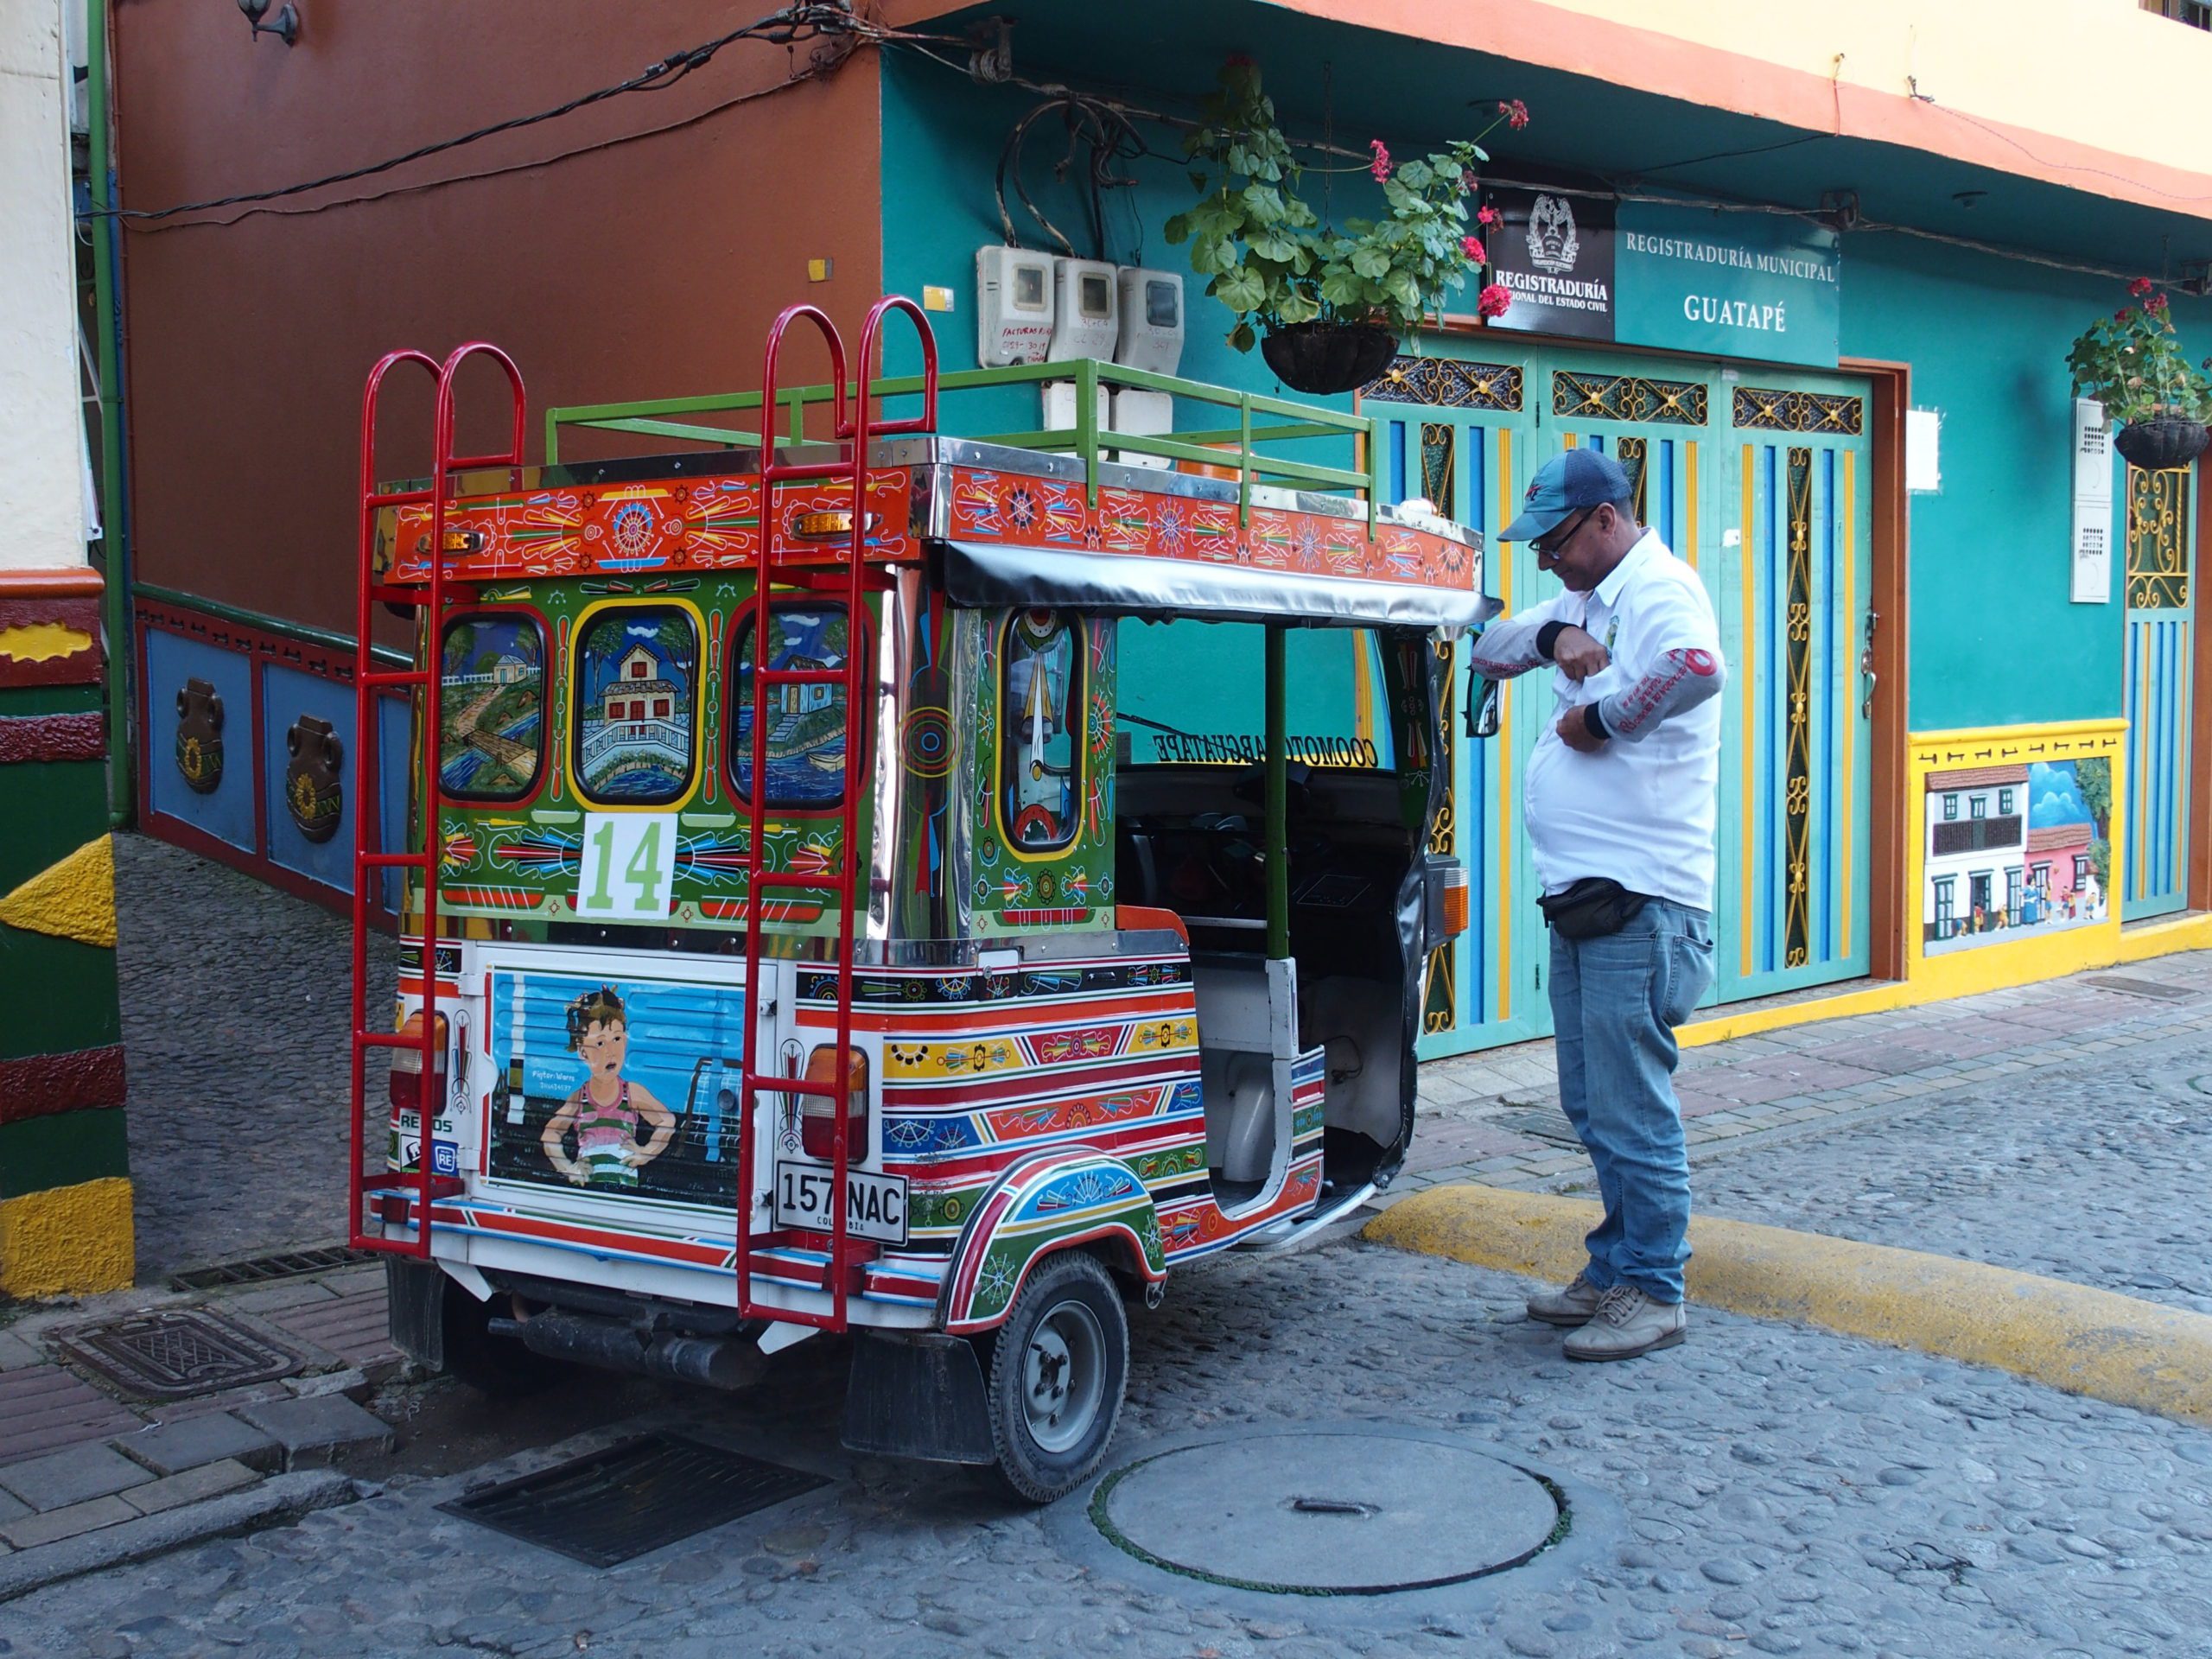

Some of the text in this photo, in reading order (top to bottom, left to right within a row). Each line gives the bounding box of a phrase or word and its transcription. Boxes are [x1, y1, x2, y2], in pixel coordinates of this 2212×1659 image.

[1626, 232, 1835, 283] REGISTRADURÍA MUNICIPAL
[1496, 270, 1608, 301] REGISTRADURÍA
[1510, 291, 1608, 312] IONAL DEL ESTADO CIVIL
[1683, 295, 1786, 334] GUATAPÉ
[586, 821, 664, 912] 14
[401, 1115, 453, 1133] REOS
[439, 1154, 453, 1166] RE
[848, 1180, 900, 1225] NAC
[817, 1216, 864, 1231] COLBIA
